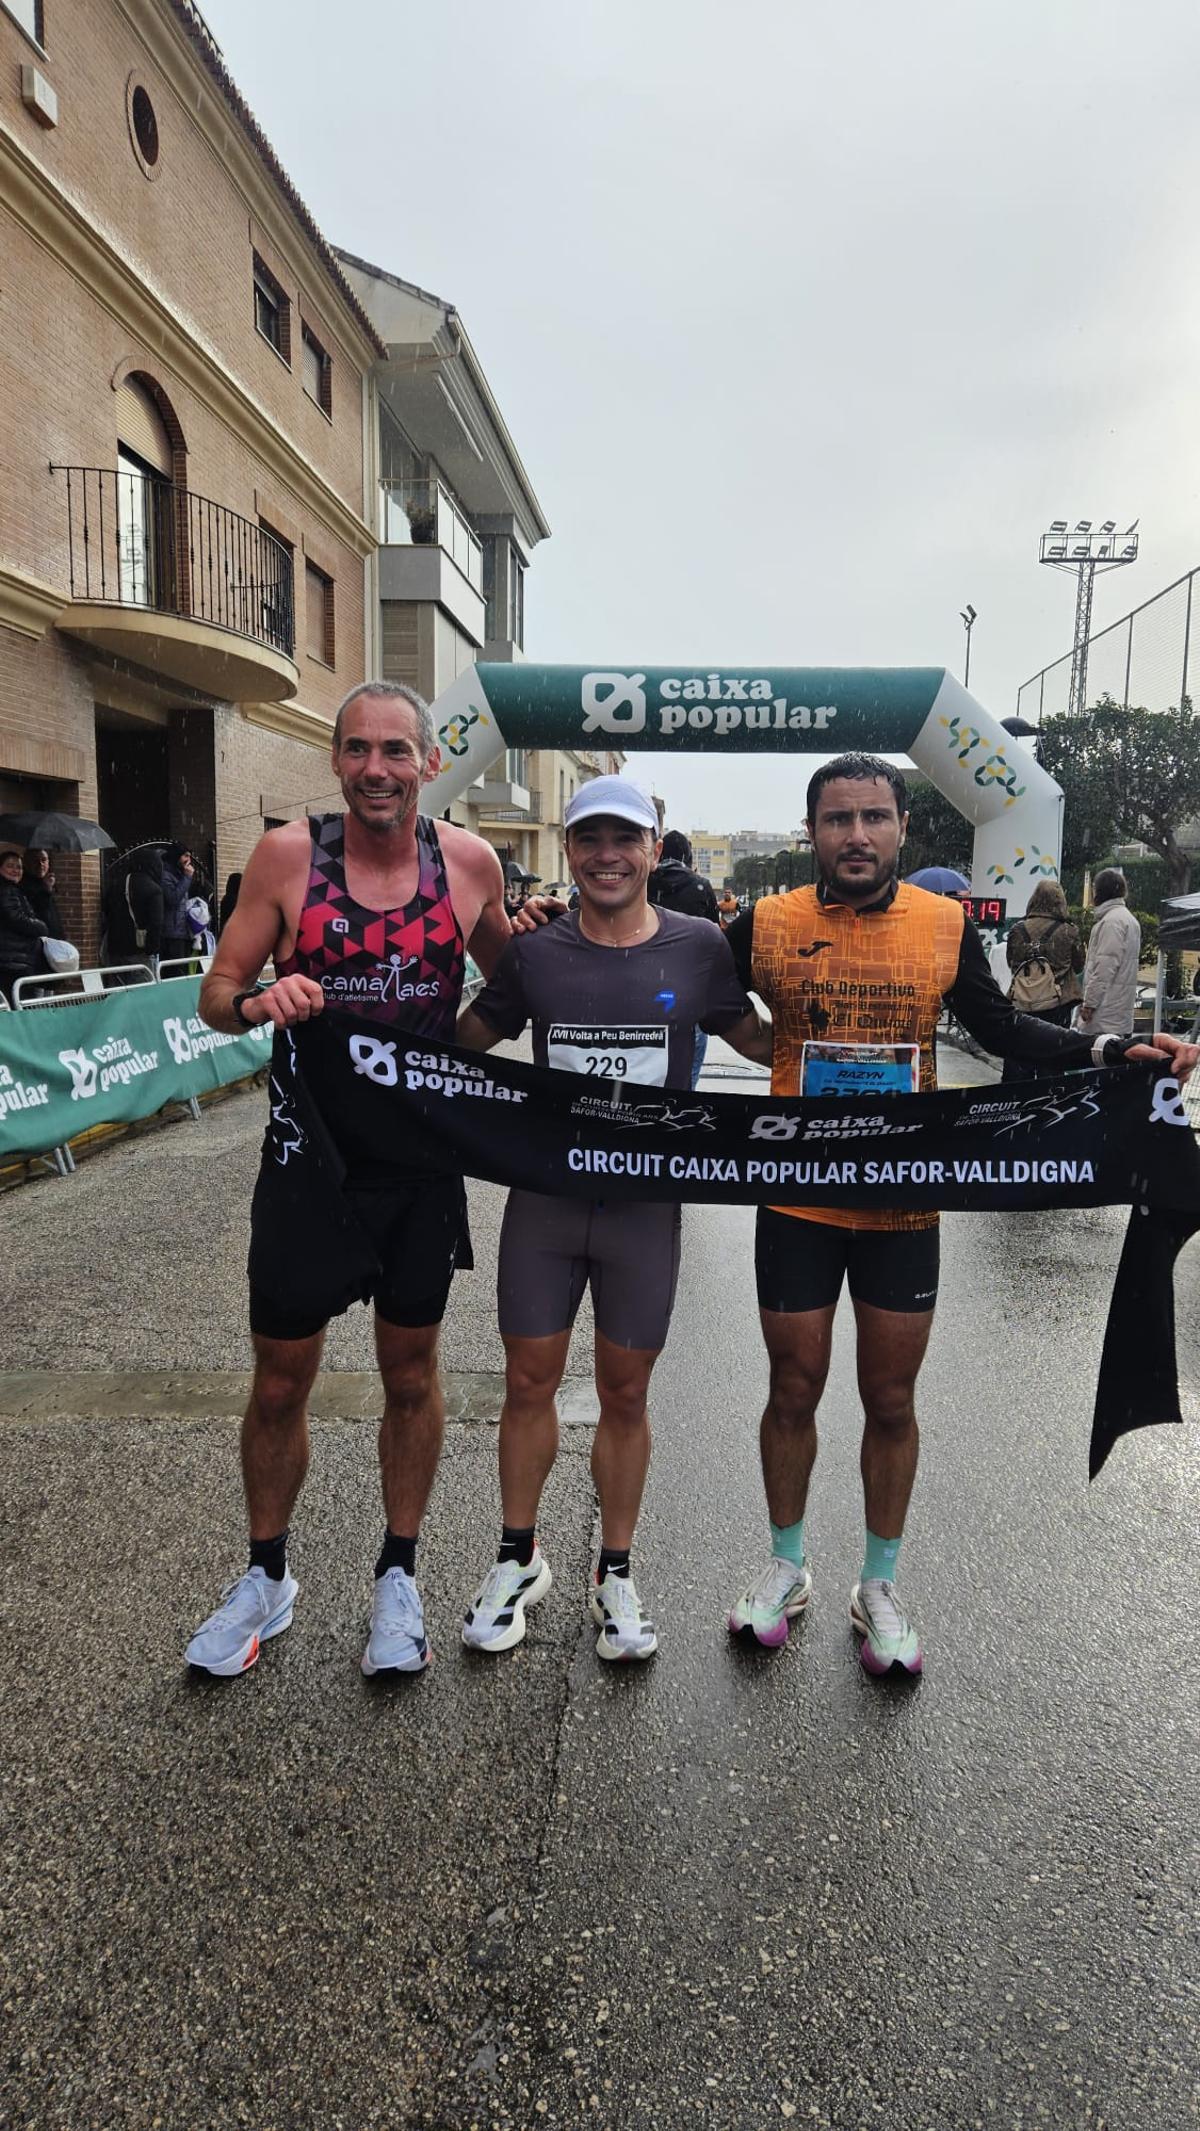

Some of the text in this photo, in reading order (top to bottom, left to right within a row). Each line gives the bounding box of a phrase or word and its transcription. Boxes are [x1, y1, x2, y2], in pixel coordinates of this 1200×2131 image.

[659, 673, 773, 700] caixa
[659, 698, 837, 735] popular
[801, 979, 915, 998] Club Deportivo
[552, 1029, 569, 1040] XVII
[570, 1030, 593, 1040] Volta
[594, 1032, 600, 1040] a
[601, 1031, 617, 1040] Peu
[100, 1051, 158, 1092] popular
[405, 1050, 485, 1079] caixa
[585, 1056, 627, 1078] 229
[836, 1070, 885, 1079] RAZYN
[405, 1069, 528, 1103] popular
[580, 1096, 632, 1111] CIRCUIT
[969, 1101, 1021, 1115] CIRCUIT
[801, 1124, 924, 1140] popular
[808, 1115, 884, 1129] caixa
[568, 1148, 1095, 1184] CIRCUIT CAIXA POPULAR SAFOR-VALLDIGNA
